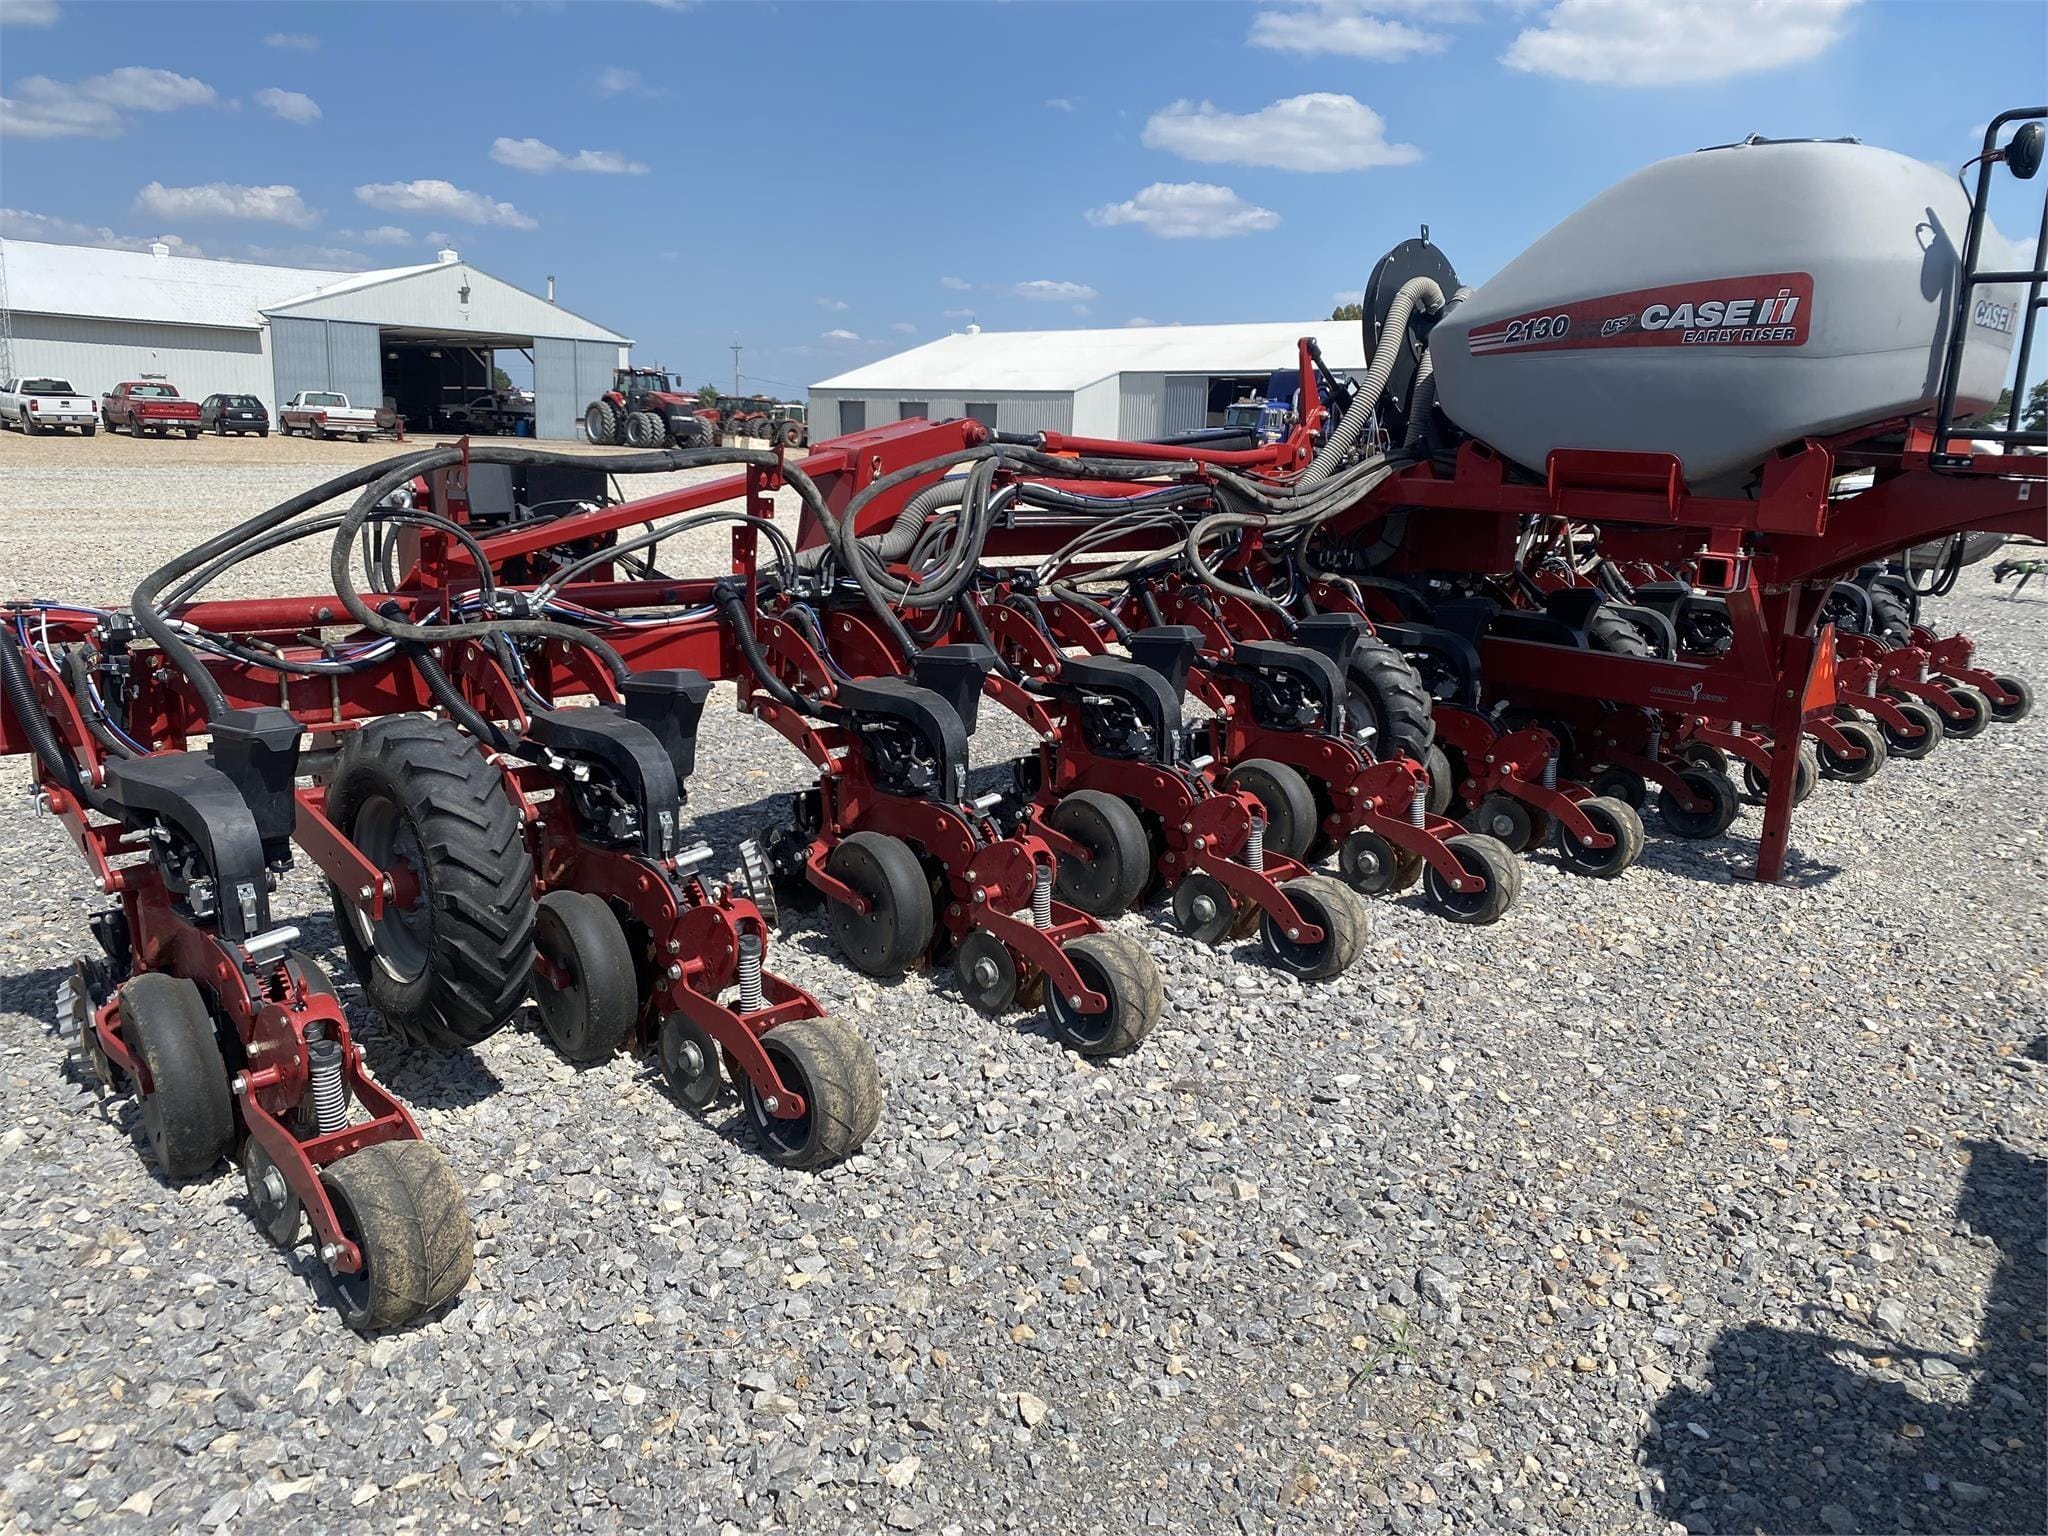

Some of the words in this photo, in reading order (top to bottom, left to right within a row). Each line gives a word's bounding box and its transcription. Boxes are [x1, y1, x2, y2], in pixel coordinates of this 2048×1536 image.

[1503, 314, 1571, 344] 2130
[1600, 316, 1629, 333] AFS
[1640, 299, 1756, 331] CASE
[1974, 299, 2008, 332] CASE
[1681, 328, 1740, 344] EARLY
[1740, 326, 1797, 342] RISER
